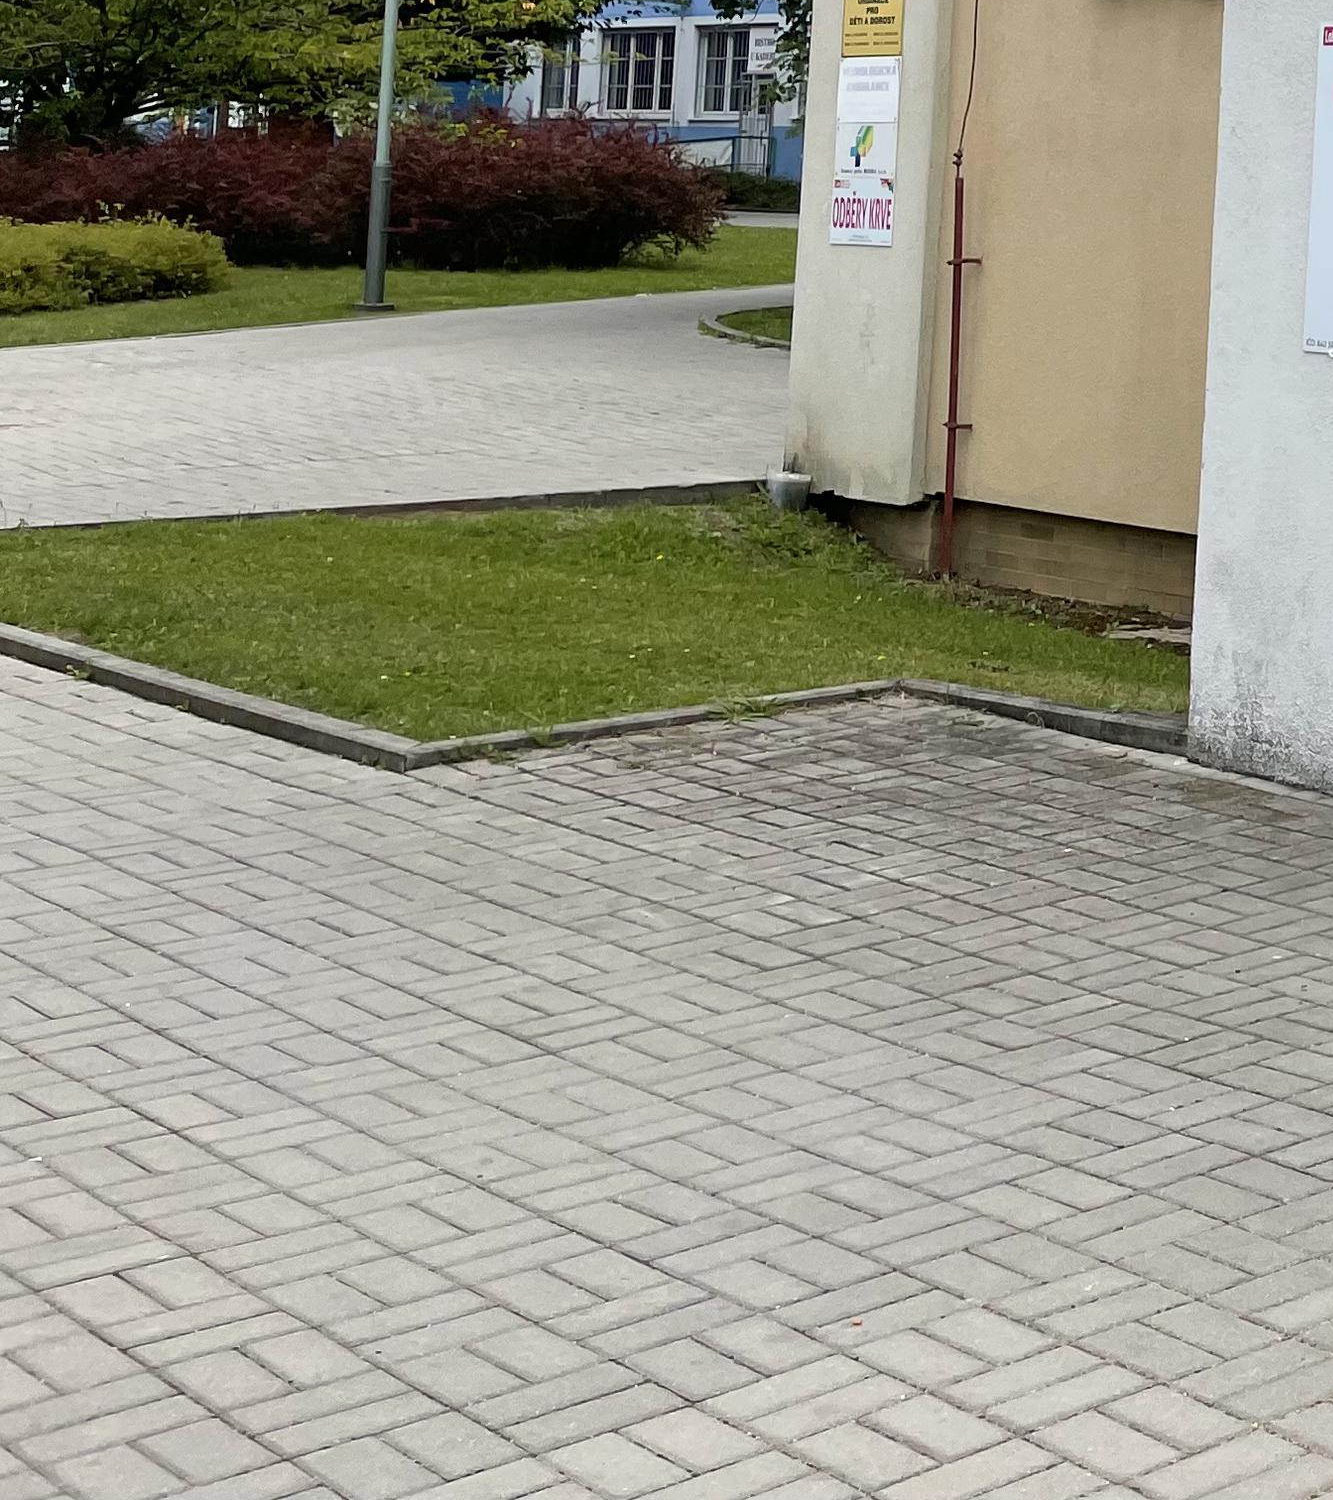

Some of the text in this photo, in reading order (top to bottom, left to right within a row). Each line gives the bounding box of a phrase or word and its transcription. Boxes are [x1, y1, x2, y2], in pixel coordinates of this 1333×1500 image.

[866, 6, 879, 14] PRO
[864, 17, 869, 25] A
[832, 191, 892, 230] ODBĚRY KRVE
